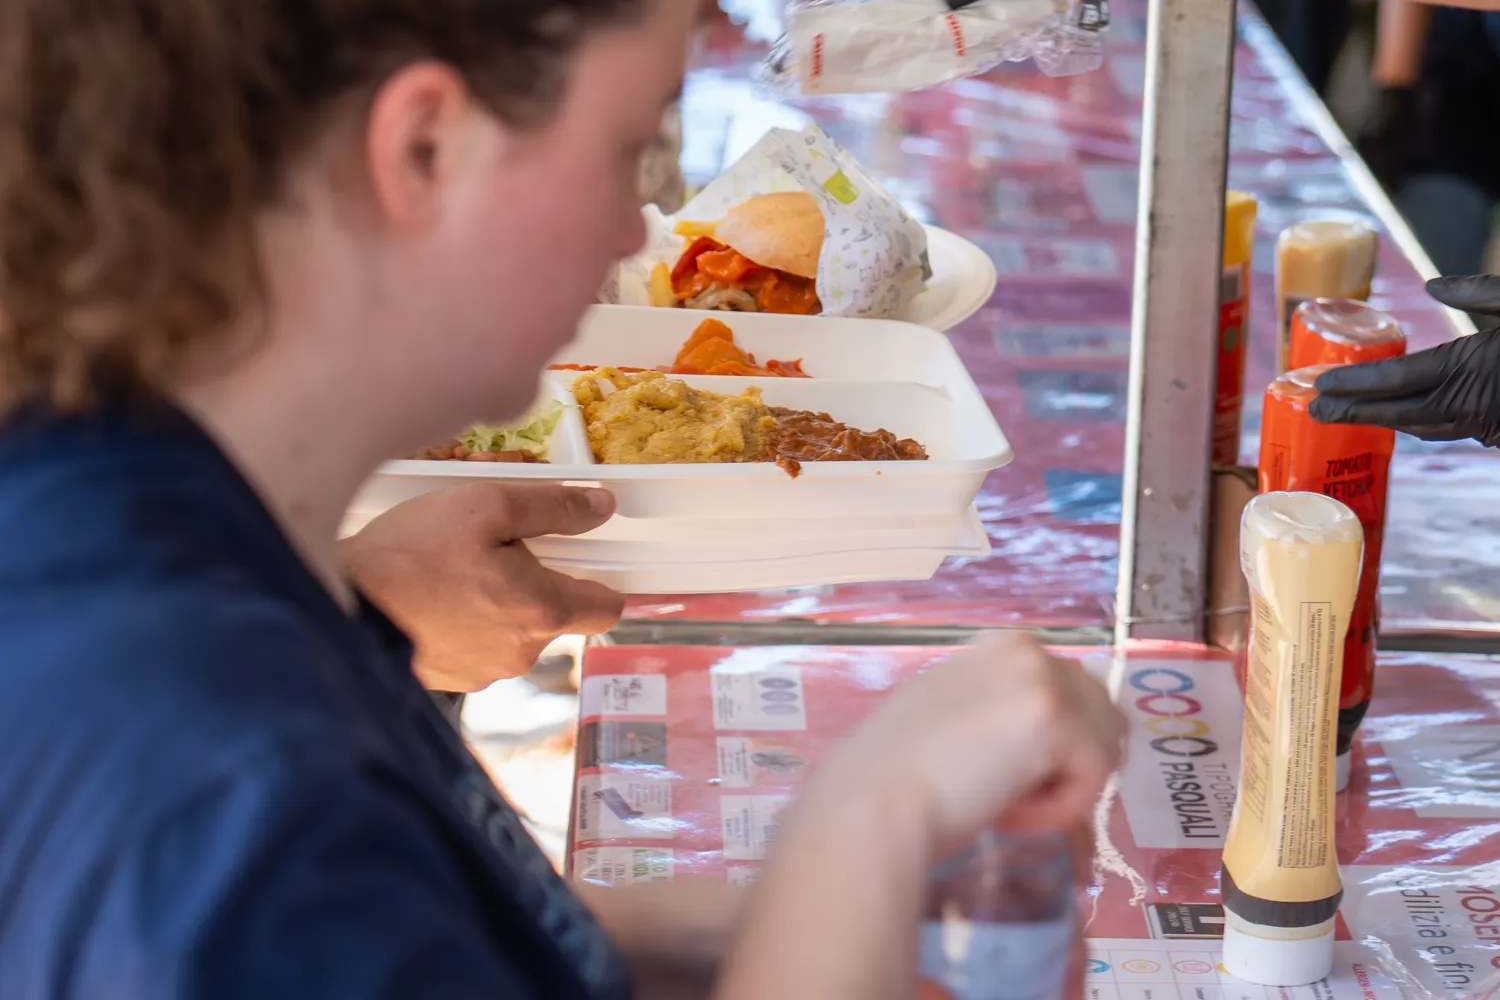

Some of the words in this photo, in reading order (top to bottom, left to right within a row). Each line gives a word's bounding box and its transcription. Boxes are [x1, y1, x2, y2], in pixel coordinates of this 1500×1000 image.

[1325, 452, 1373, 479] TOMATO
[1323, 474, 1375, 500] KETCHUP
[1158, 761, 1221, 839] PASQUALI
